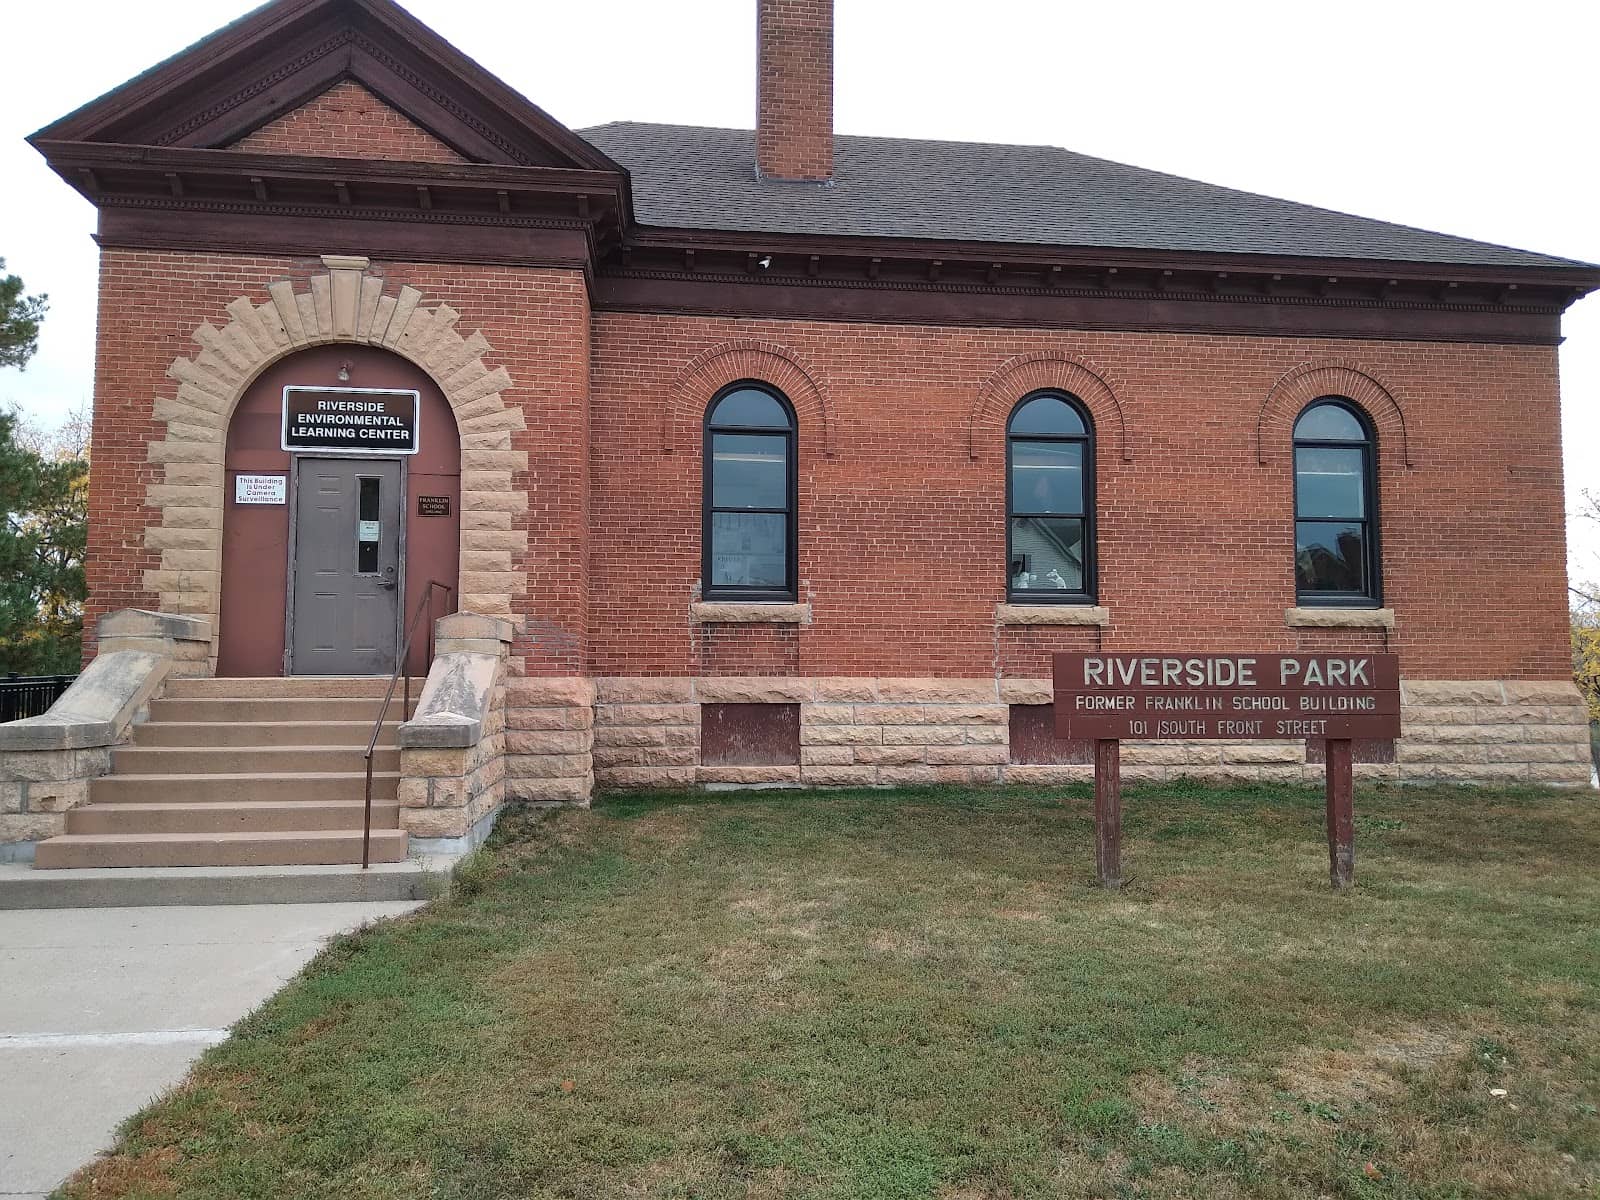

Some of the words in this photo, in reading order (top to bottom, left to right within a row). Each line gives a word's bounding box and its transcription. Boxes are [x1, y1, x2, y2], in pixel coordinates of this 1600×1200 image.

[317, 400, 385, 412] RIVERSIDE
[298, 413, 404, 426] ENVIRONMENTAL
[291, 427, 356, 438] LEARNING
[359, 428, 410, 440] CENTER
[254, 478, 283, 486] Building
[1083, 658, 1257, 687] RIVERSIDE
[1280, 658, 1369, 687] PARK
[1075, 695, 1136, 711] FORMER
[1145, 696, 1223, 711] FRANKLIN
[1232, 696, 1290, 711] SCHOOL
[1300, 696, 1376, 711] BUILDING
[1128, 720, 1148, 735] 101
[1159, 720, 1206, 735] SOUTH
[1217, 720, 1263, 735] FRONT
[1276, 720, 1328, 735] STREET
